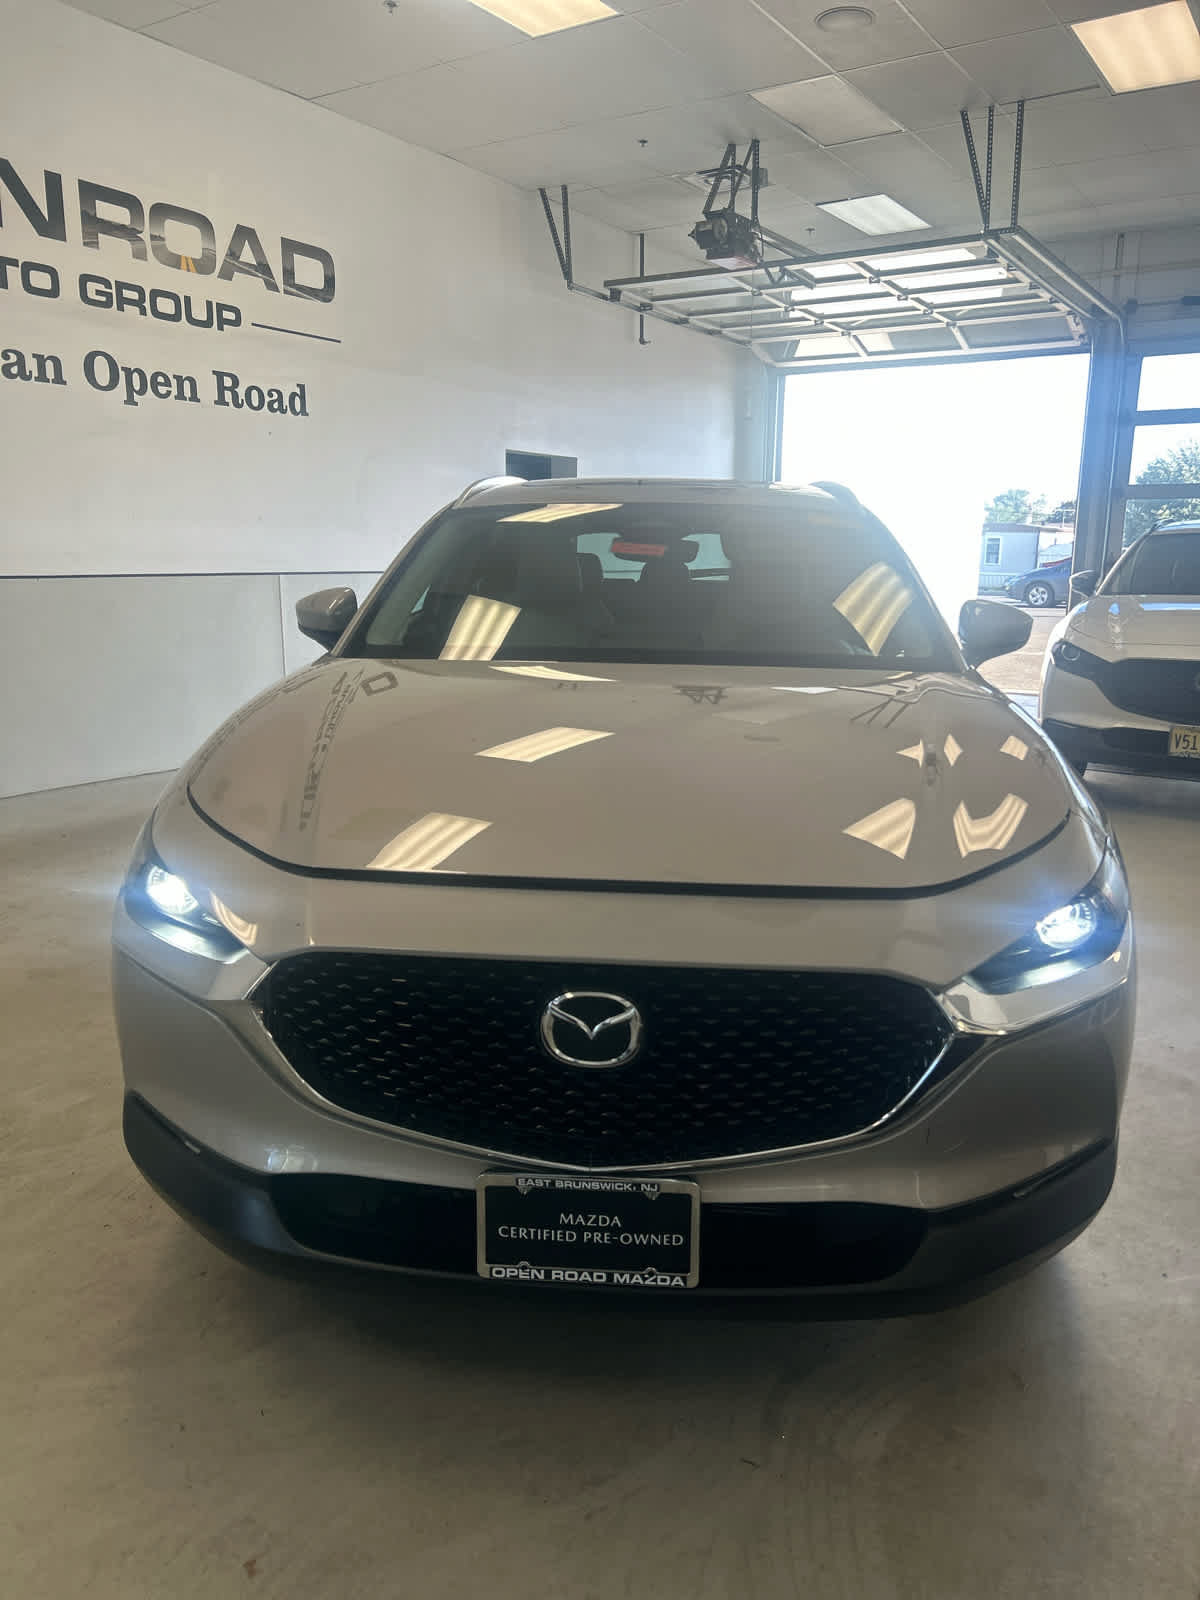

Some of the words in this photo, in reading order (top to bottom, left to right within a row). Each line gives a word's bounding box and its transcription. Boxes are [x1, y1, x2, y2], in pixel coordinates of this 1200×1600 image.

[78, 273, 242, 331] GROUP
[0, 349, 67, 386] an
[83, 350, 200, 407] Open
[212, 370, 309, 416] Road
[517, 1178, 551, 1188] EAST
[640, 1183, 658, 1192] NJ
[559, 1213, 622, 1227] MAZDA
[498, 1226, 577, 1242] CERTIFIED
[583, 1232, 684, 1246] PRE-OWNED
[491, 1267, 544, 1280] OPEN
[551, 1270, 606, 1283] ROAD
[613, 1273, 685, 1287] MAZDA
